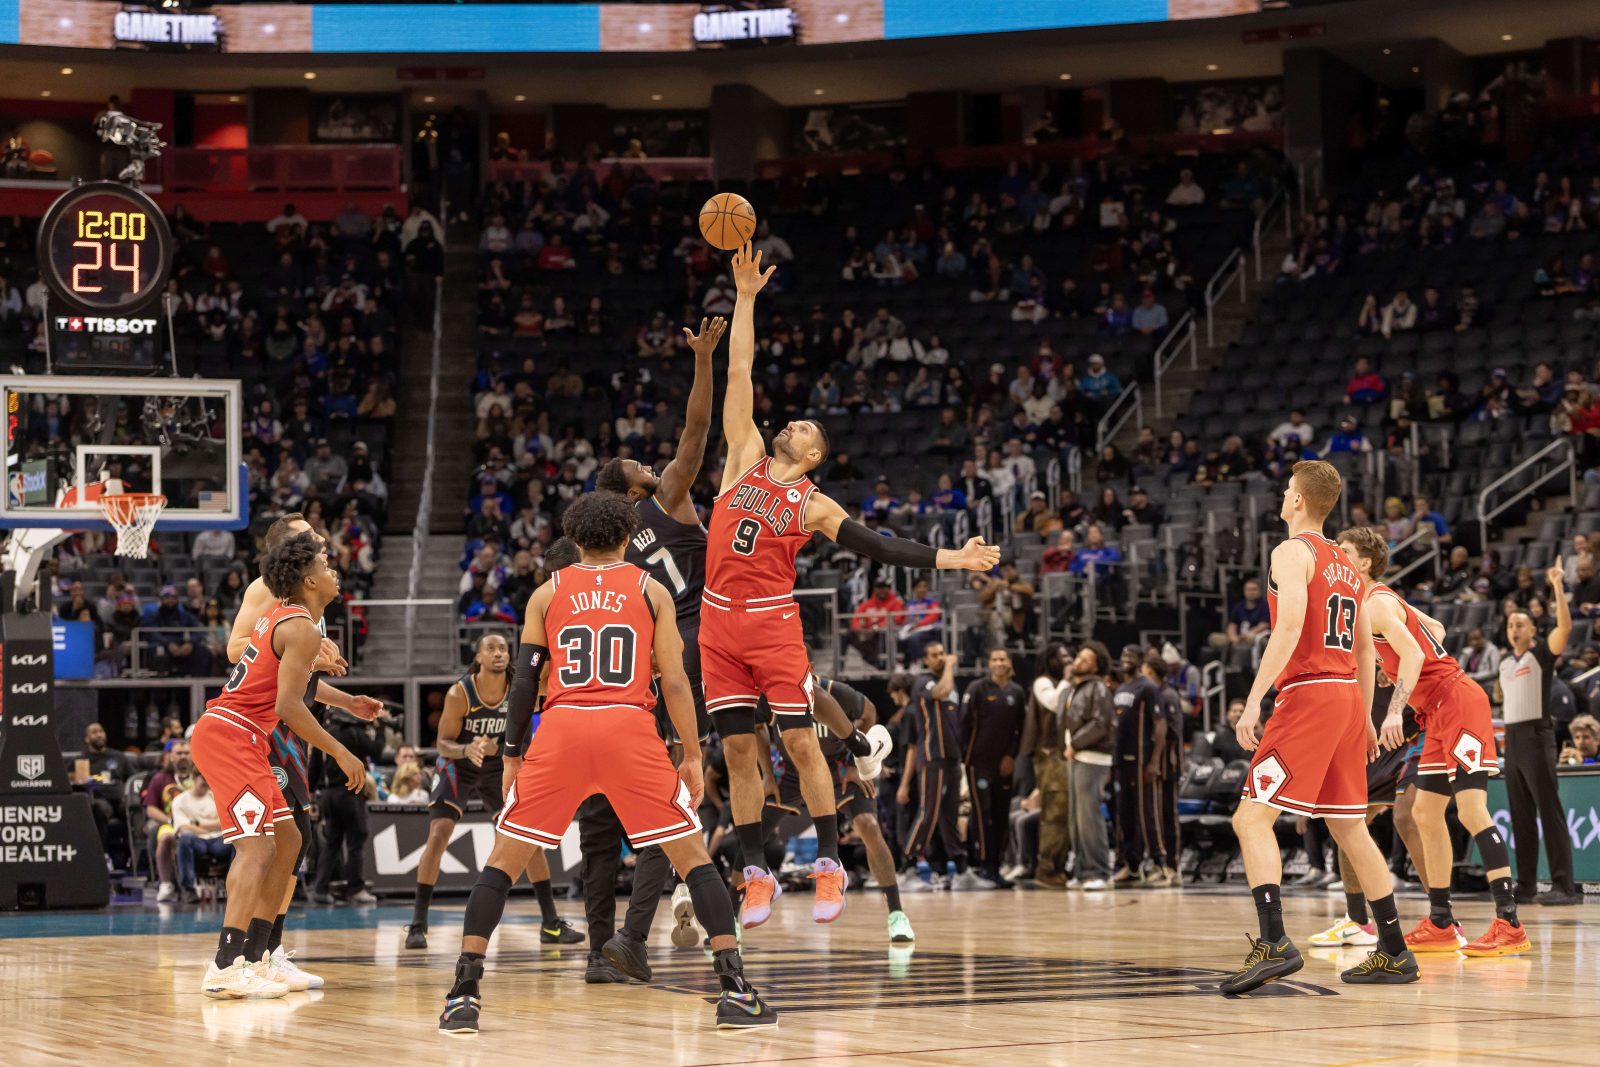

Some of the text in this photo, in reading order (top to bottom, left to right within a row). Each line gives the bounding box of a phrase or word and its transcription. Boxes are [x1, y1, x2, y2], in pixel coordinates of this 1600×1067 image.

[79, 211, 145, 240] 12:00
[73, 241, 139, 294] 24
[84, 317, 157, 334] TISSOT
[728, 484, 794, 536] BULLS
[632, 528, 656, 552] REED
[732, 517, 761, 556] 9
[646, 547, 685, 594] 7
[570, 591, 627, 614] JONES
[1324, 593, 1357, 653] 13
[558, 624, 637, 687] 30
[11, 780, 52, 788] GAMEABOVE
[0, 825, 46, 843] ORD
